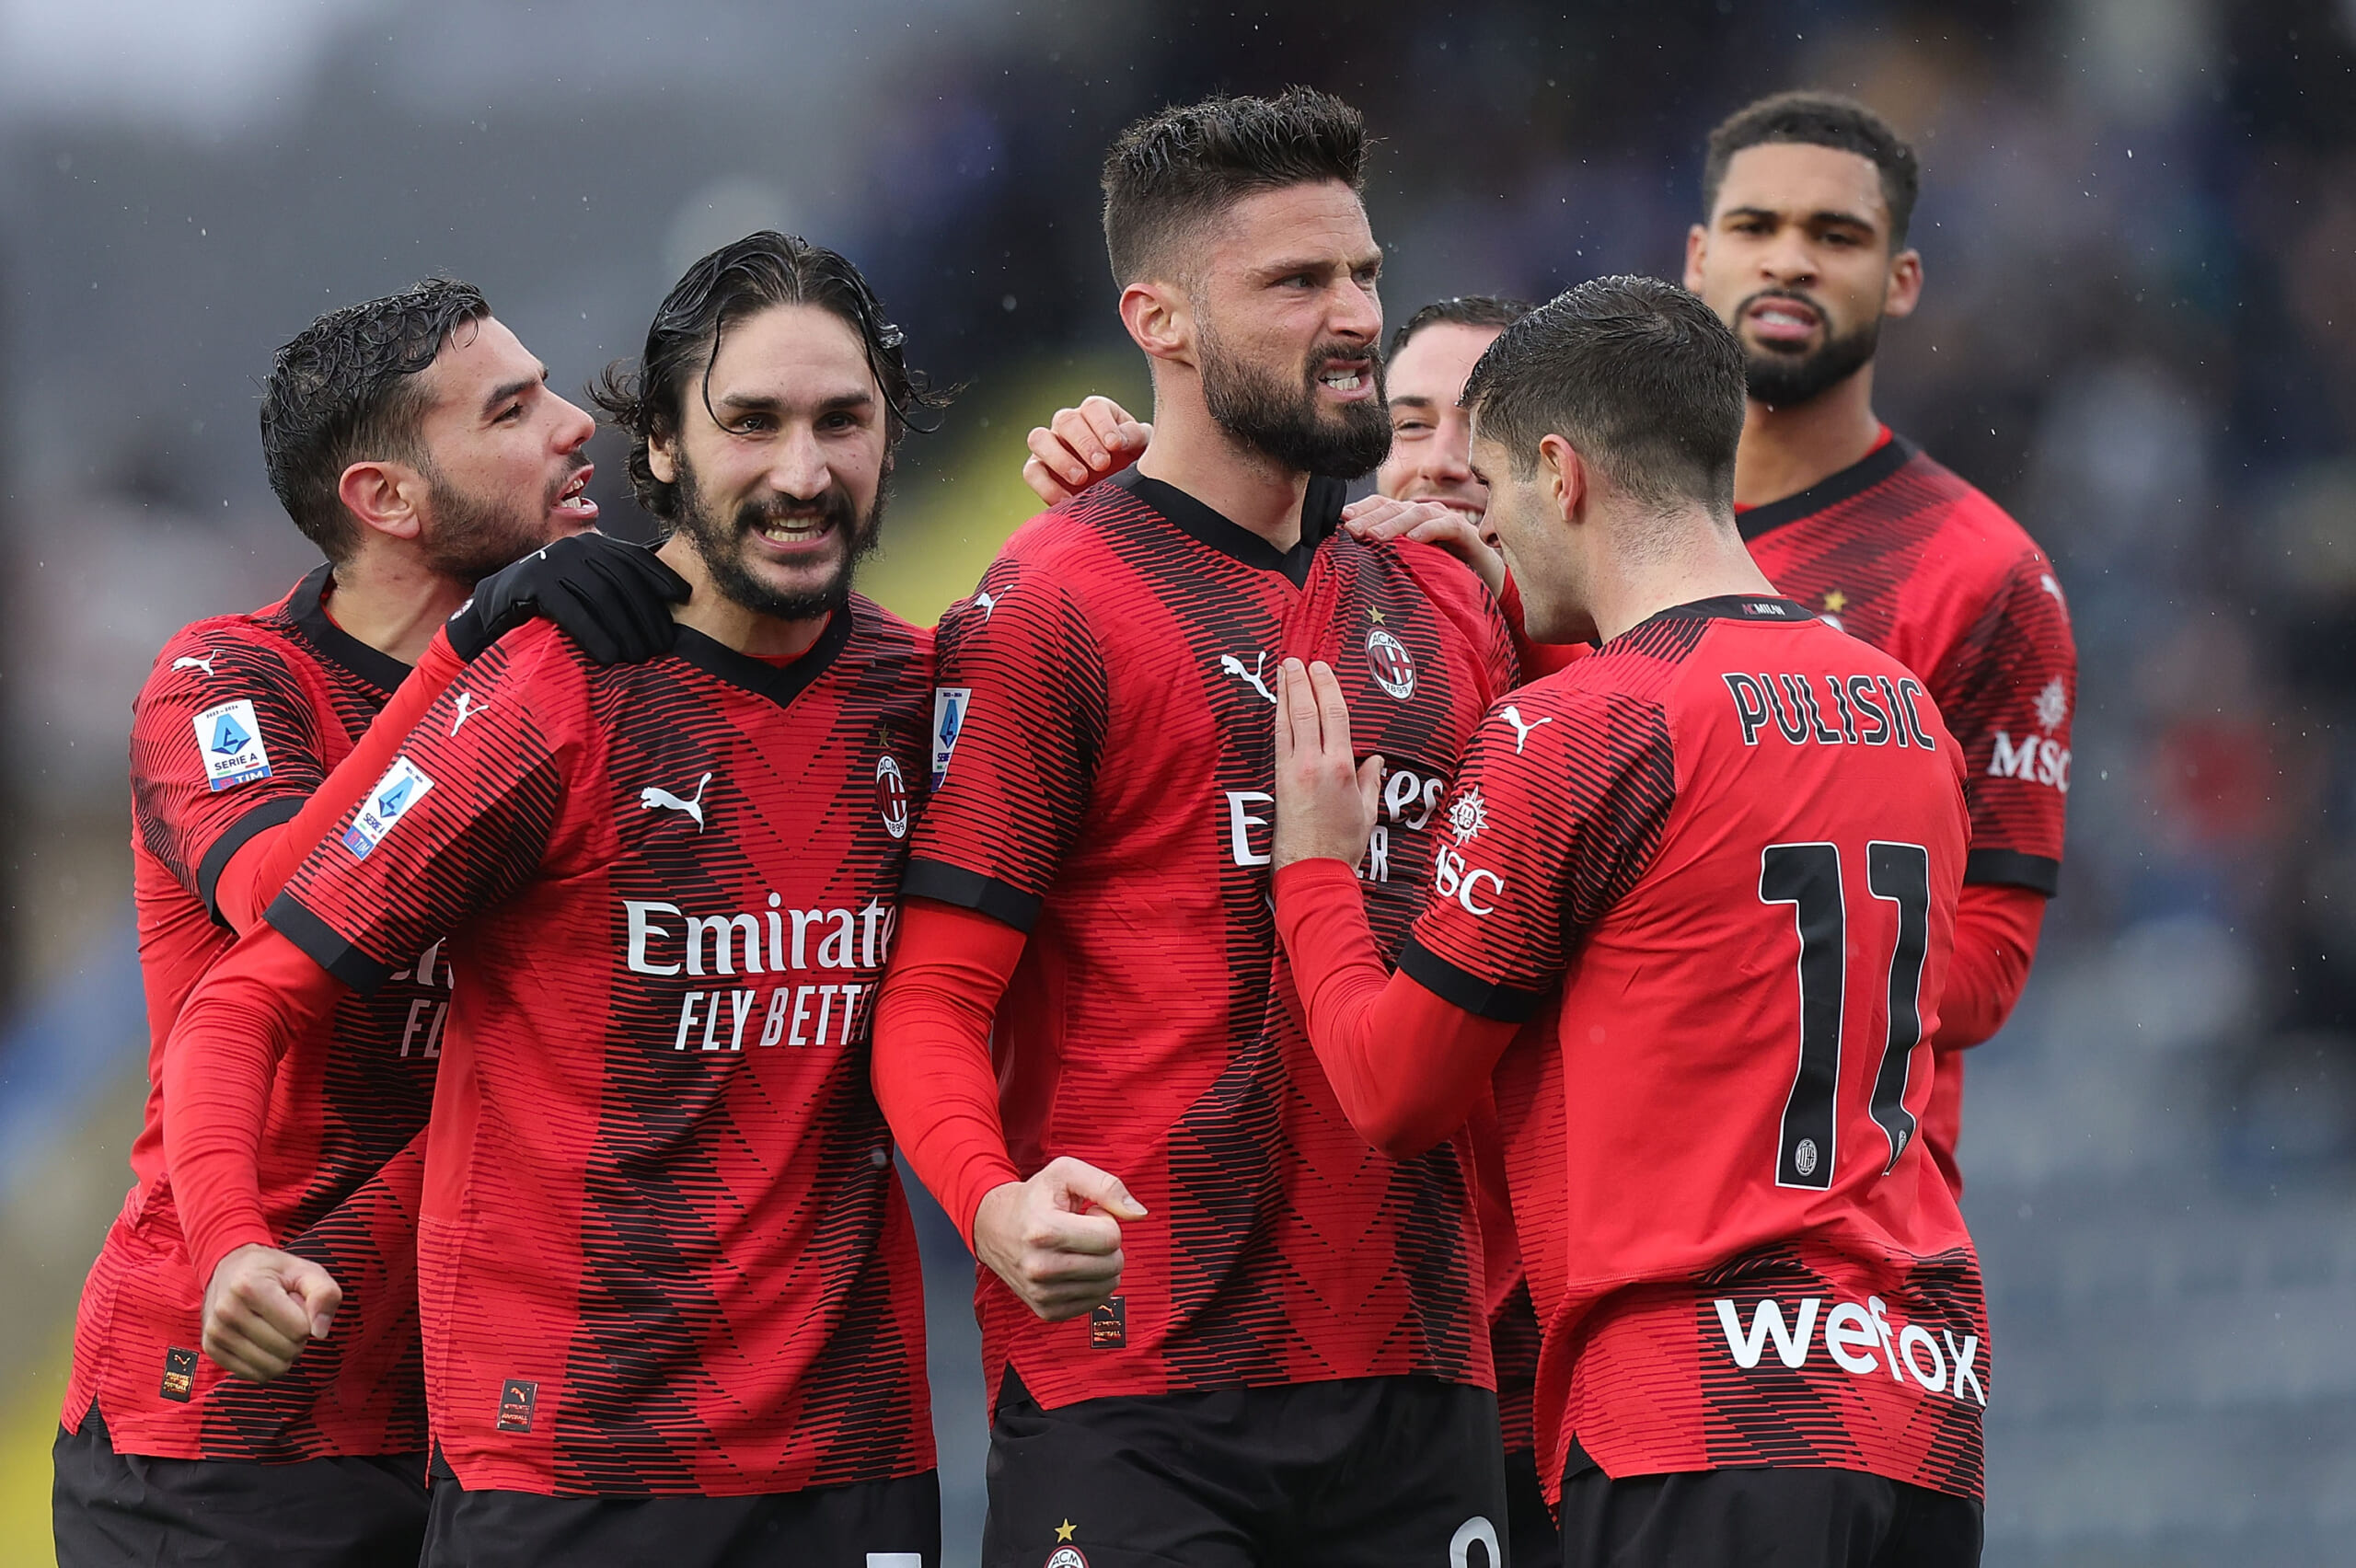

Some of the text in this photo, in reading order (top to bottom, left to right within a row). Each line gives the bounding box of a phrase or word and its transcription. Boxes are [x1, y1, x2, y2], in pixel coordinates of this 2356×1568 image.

[1371, 633, 1399, 648] ACM
[1385, 684, 1409, 694] 1899
[1721, 672, 1936, 752] PULISIC
[214, 753, 259, 771] SERIE A
[878, 758, 900, 773] ACM
[236, 770, 264, 784] TIM
[888, 822, 906, 832] 1899
[675, 990, 756, 1051] FLY
[1758, 840, 1932, 1191] 11
[1714, 1295, 1987, 1407] wefox
[1052, 1551, 1079, 1565] ACM
